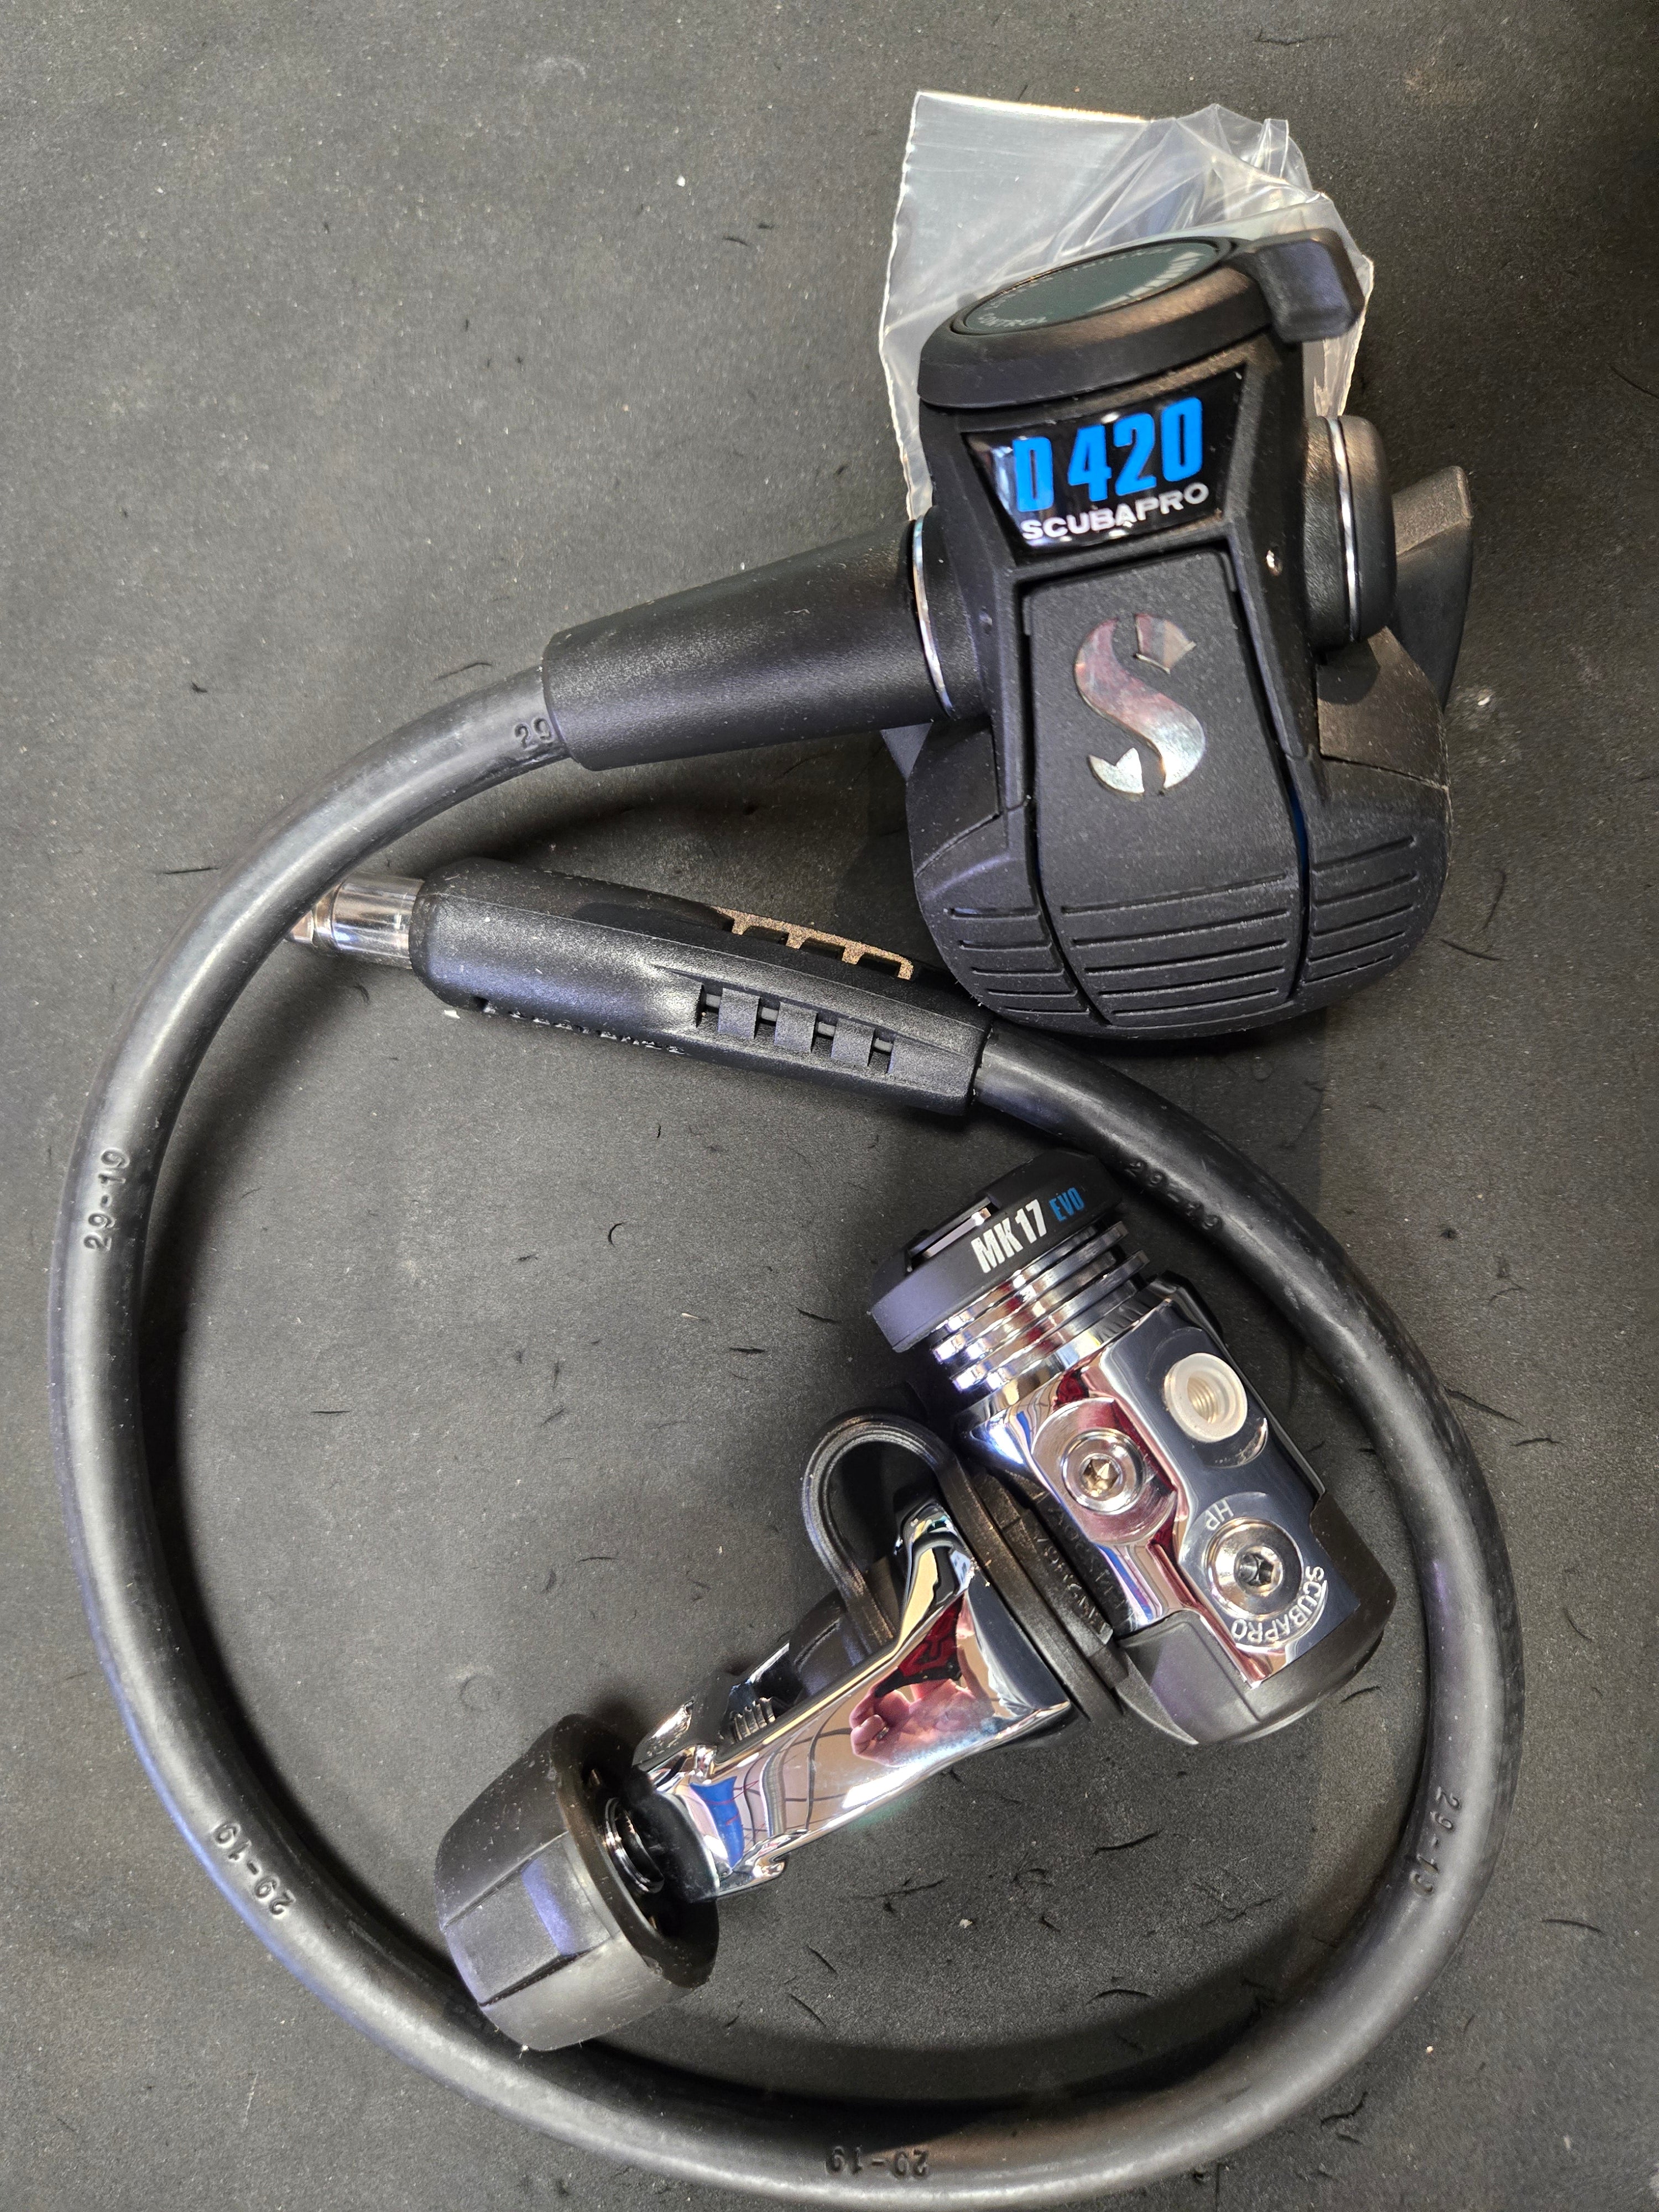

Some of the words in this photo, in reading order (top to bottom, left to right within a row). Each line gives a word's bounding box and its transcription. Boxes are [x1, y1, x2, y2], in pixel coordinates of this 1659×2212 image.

[1013, 436, 1054, 513] D
[1067, 397, 1204, 503] 420
[1022, 482, 1209, 541] SCUBAPRO
[83, 1147, 131, 1253] 29-19
[1048, 1187, 1085, 1222] EVO
[1205, 1499, 1234, 1531] HP
[1231, 1566, 1325, 1645] SCUBAPRO
[212, 1823, 296, 1919] 29-19
